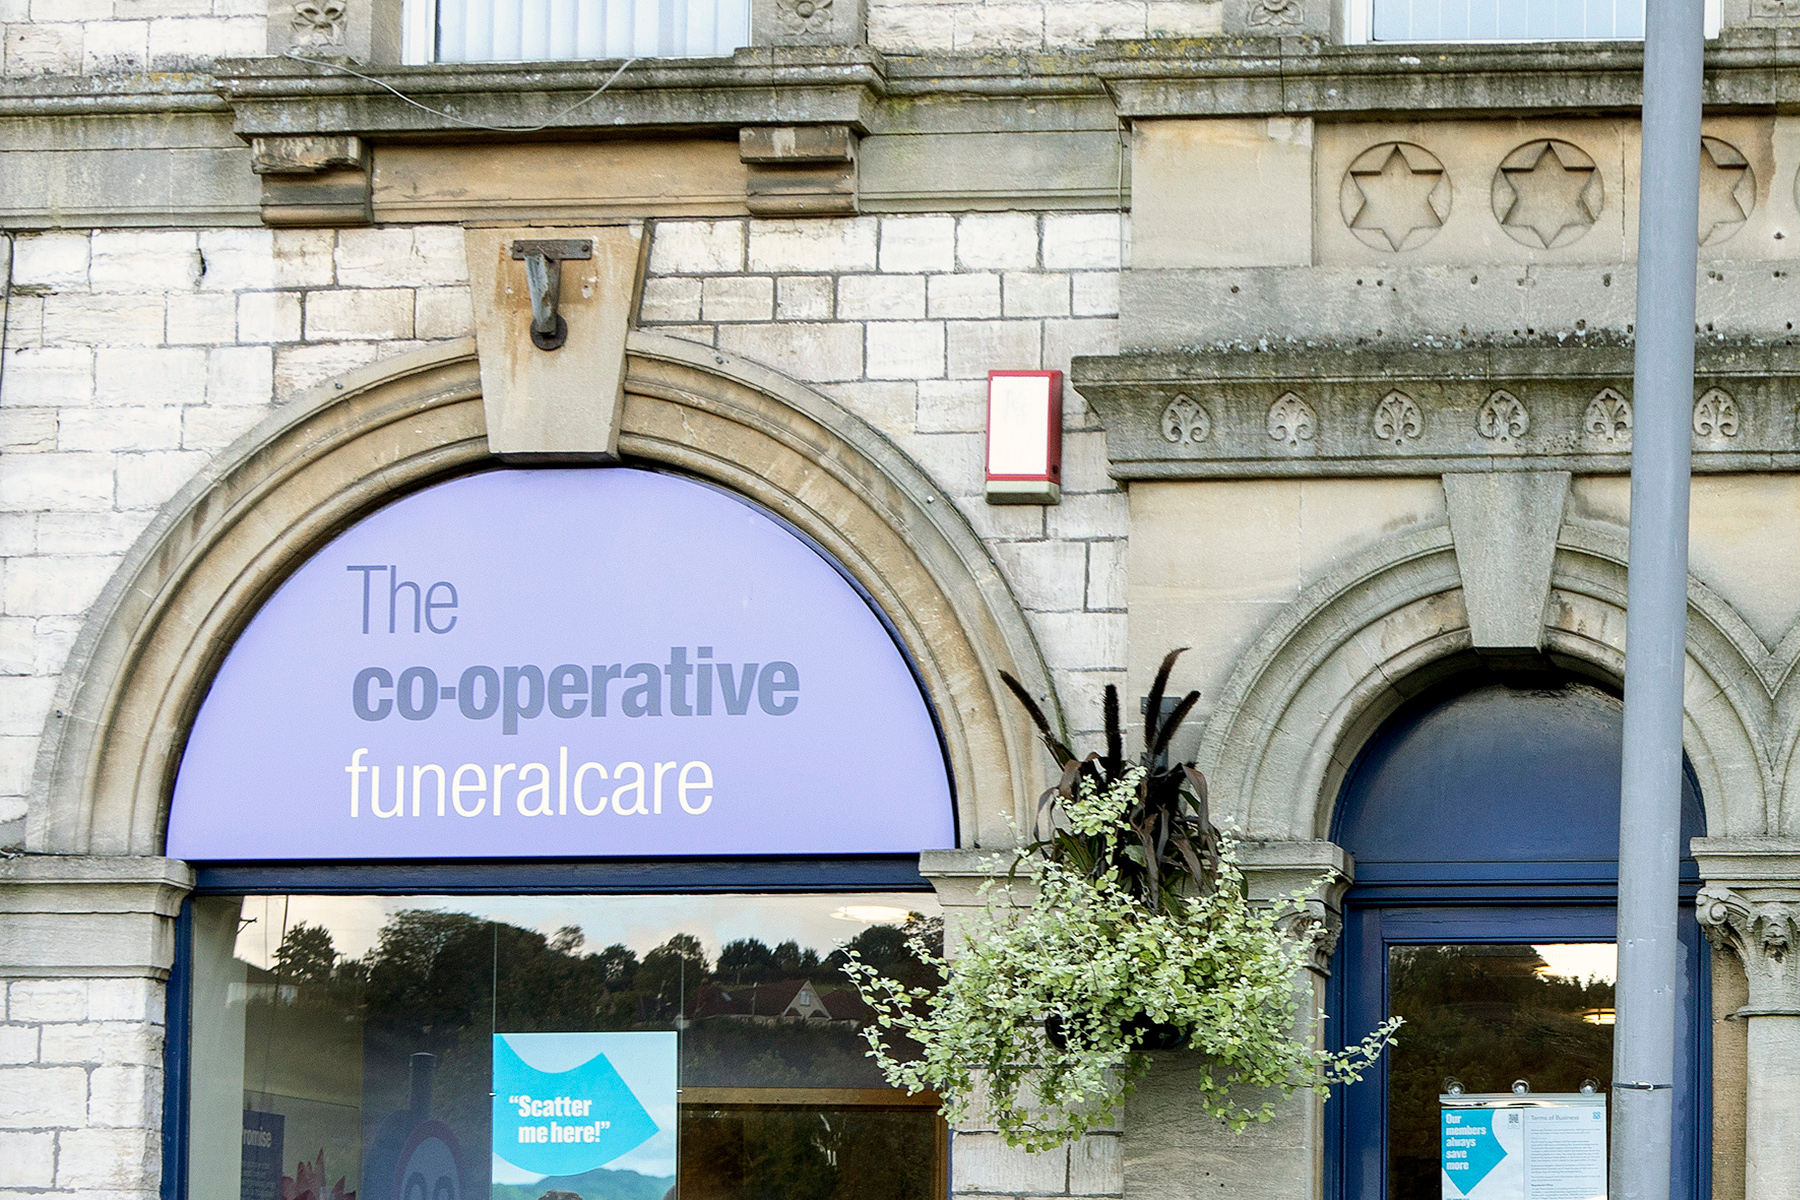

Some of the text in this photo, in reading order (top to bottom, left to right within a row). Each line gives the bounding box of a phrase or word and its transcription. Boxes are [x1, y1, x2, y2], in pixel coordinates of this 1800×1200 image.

[346, 565, 458, 634] The
[352, 646, 800, 735] co-operative
[345, 746, 714, 818] funeralcare
[1446, 1113, 1462, 1124] Our
[518, 1126, 548, 1144] me
[1446, 1125, 1487, 1136] members
[1446, 1137, 1476, 1148] always
[1446, 1150, 1467, 1159] save
[1446, 1161, 1469, 1171] more
